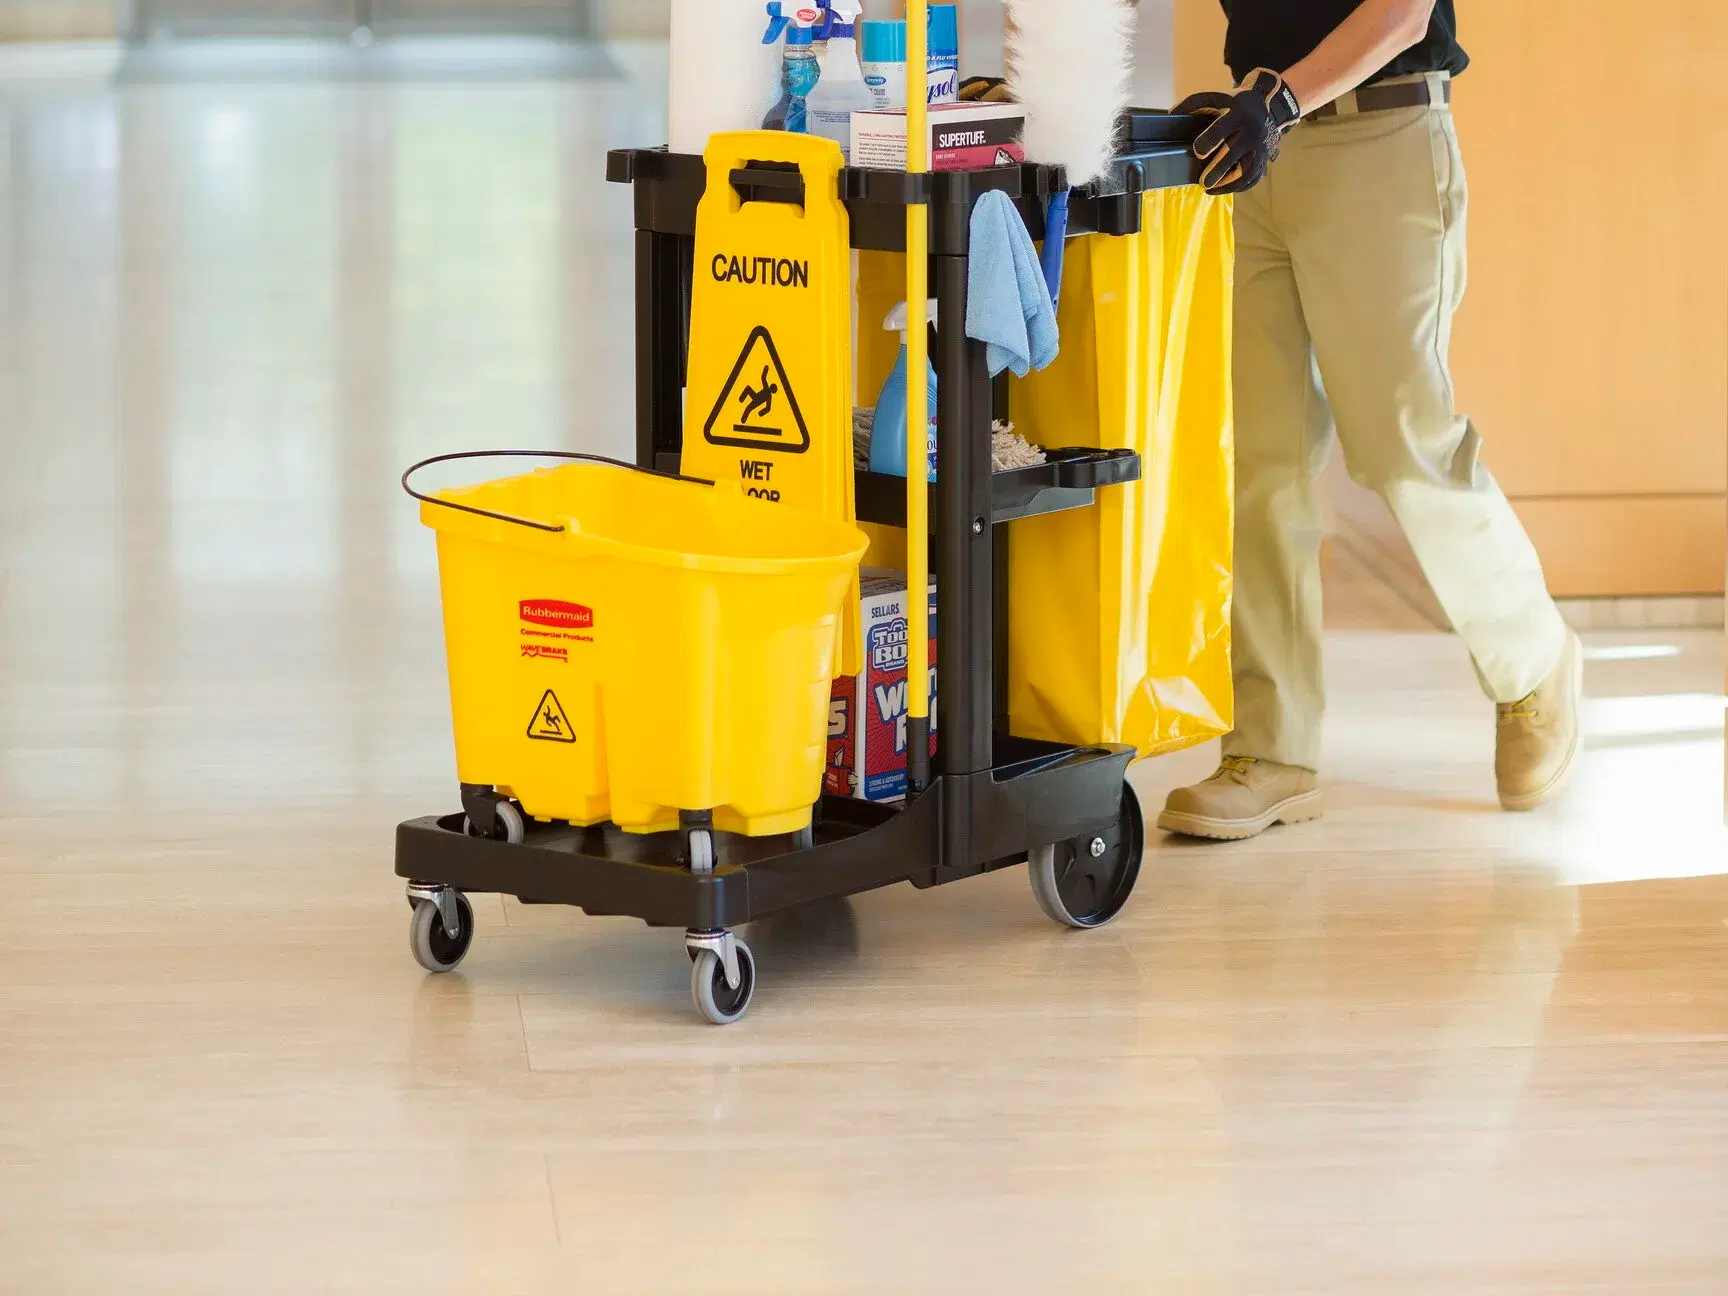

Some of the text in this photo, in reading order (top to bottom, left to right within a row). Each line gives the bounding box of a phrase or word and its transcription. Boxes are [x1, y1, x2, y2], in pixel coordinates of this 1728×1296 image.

[926, 71, 957, 104] ysol
[939, 130, 985, 148] SUPERTUFF
[711, 253, 808, 288] CAUTION
[740, 459, 774, 481] WET
[747, 487, 780, 502] OOR
[523, 606, 590, 621] Rubbermaid
[871, 603, 900, 618] SELLARS
[520, 628, 594, 642] Commercial Products
[874, 630, 908, 645] TOO
[875, 644, 908, 664] BO
